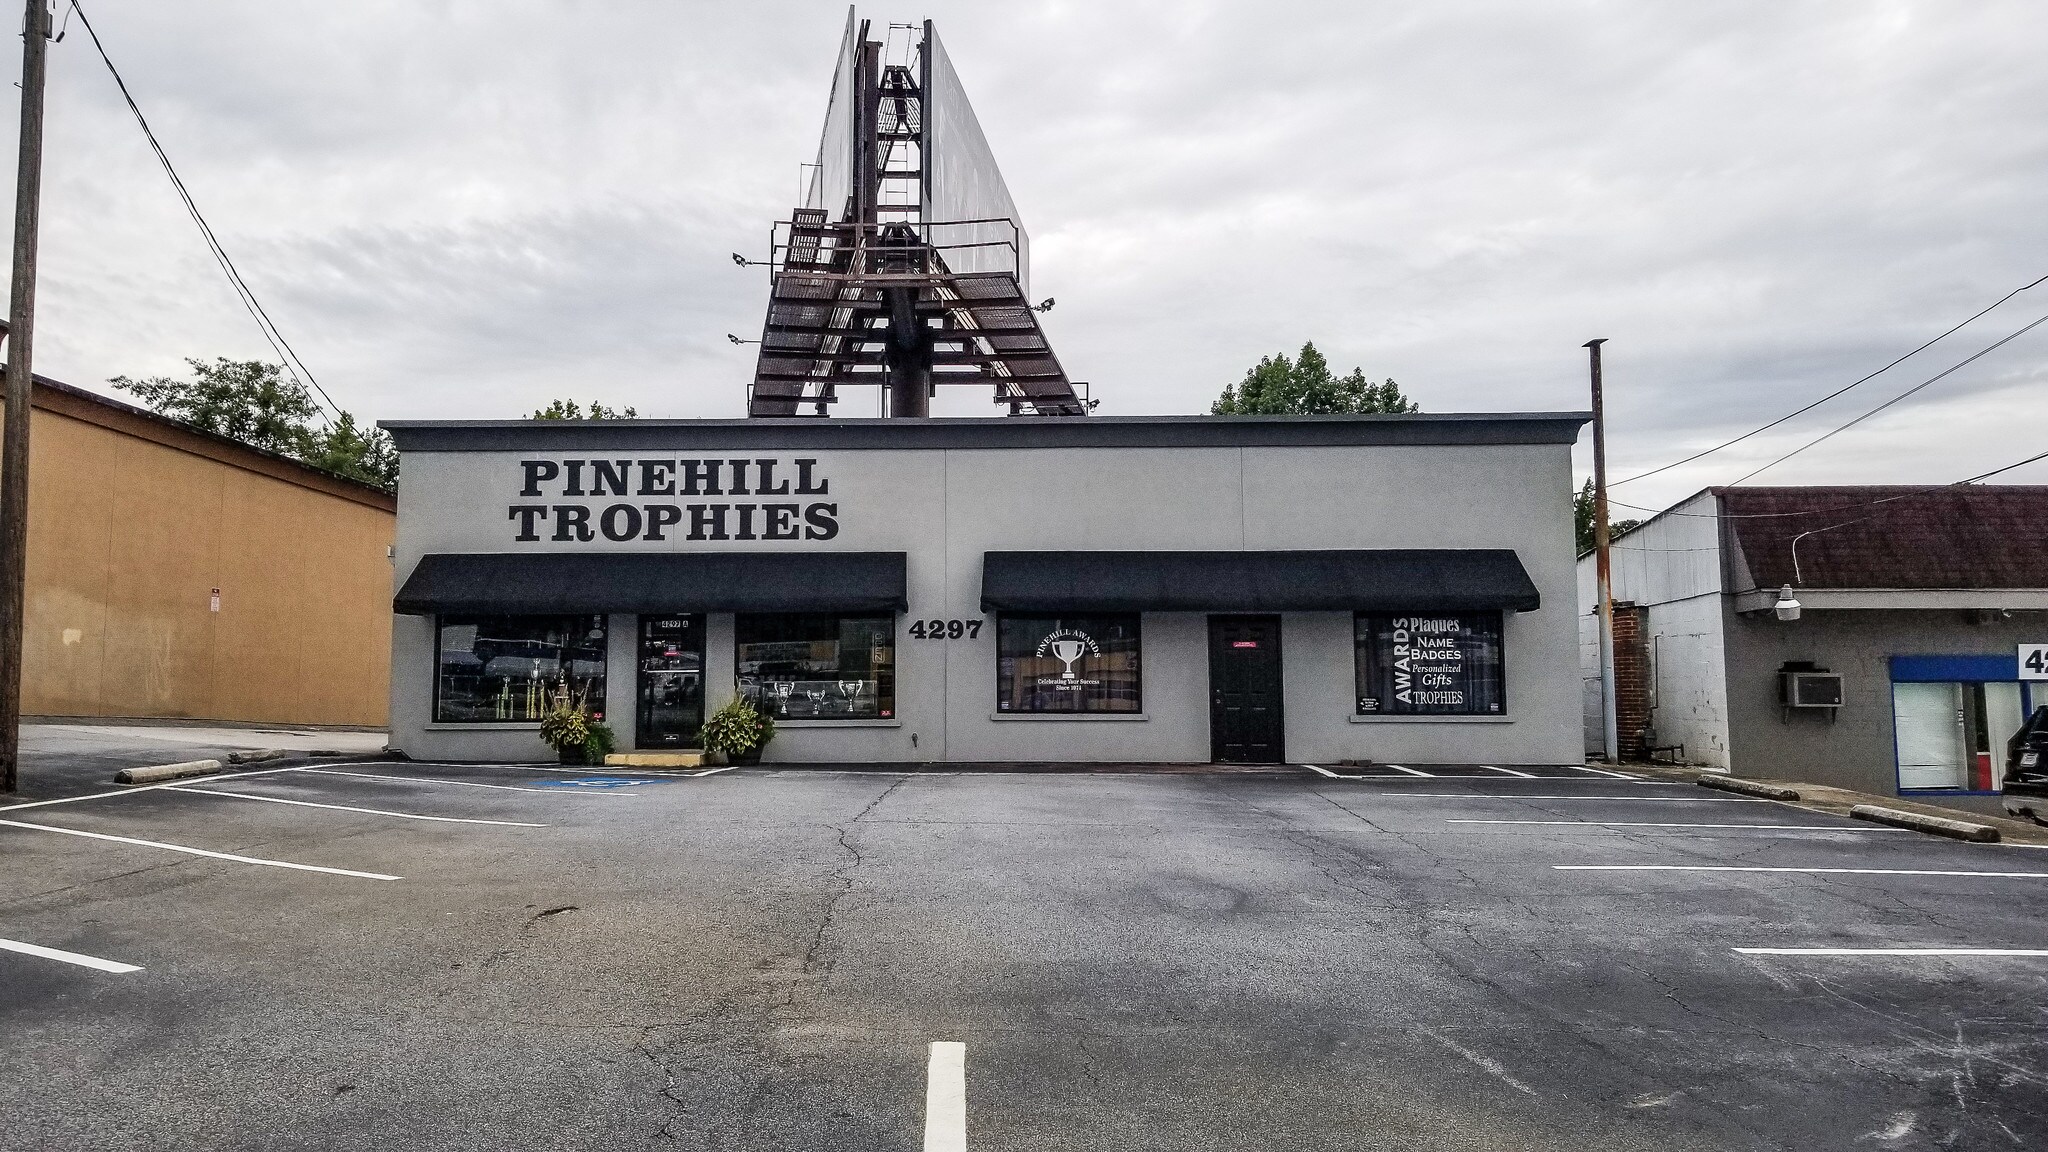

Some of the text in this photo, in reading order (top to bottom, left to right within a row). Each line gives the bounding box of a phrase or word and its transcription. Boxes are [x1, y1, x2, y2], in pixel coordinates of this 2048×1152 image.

[520, 459, 829, 496] PINEHILL
[509, 503, 839, 542] TROPHIES
[908, 619, 984, 640] 4297
[1410, 617, 1460, 634] Plaques
[1036, 629, 1101, 658] PINEHILL AWARDS
[1417, 636, 1455, 648] NAME
[1393, 617, 1412, 704] AWARDS
[1411, 648, 1462, 660] BADGES
[2025, 649, 2048, 674] 4
[1412, 663, 1462, 674] Personalized
[1422, 673, 1452, 689] Gifts
[1413, 690, 1464, 705] TROPHIES
